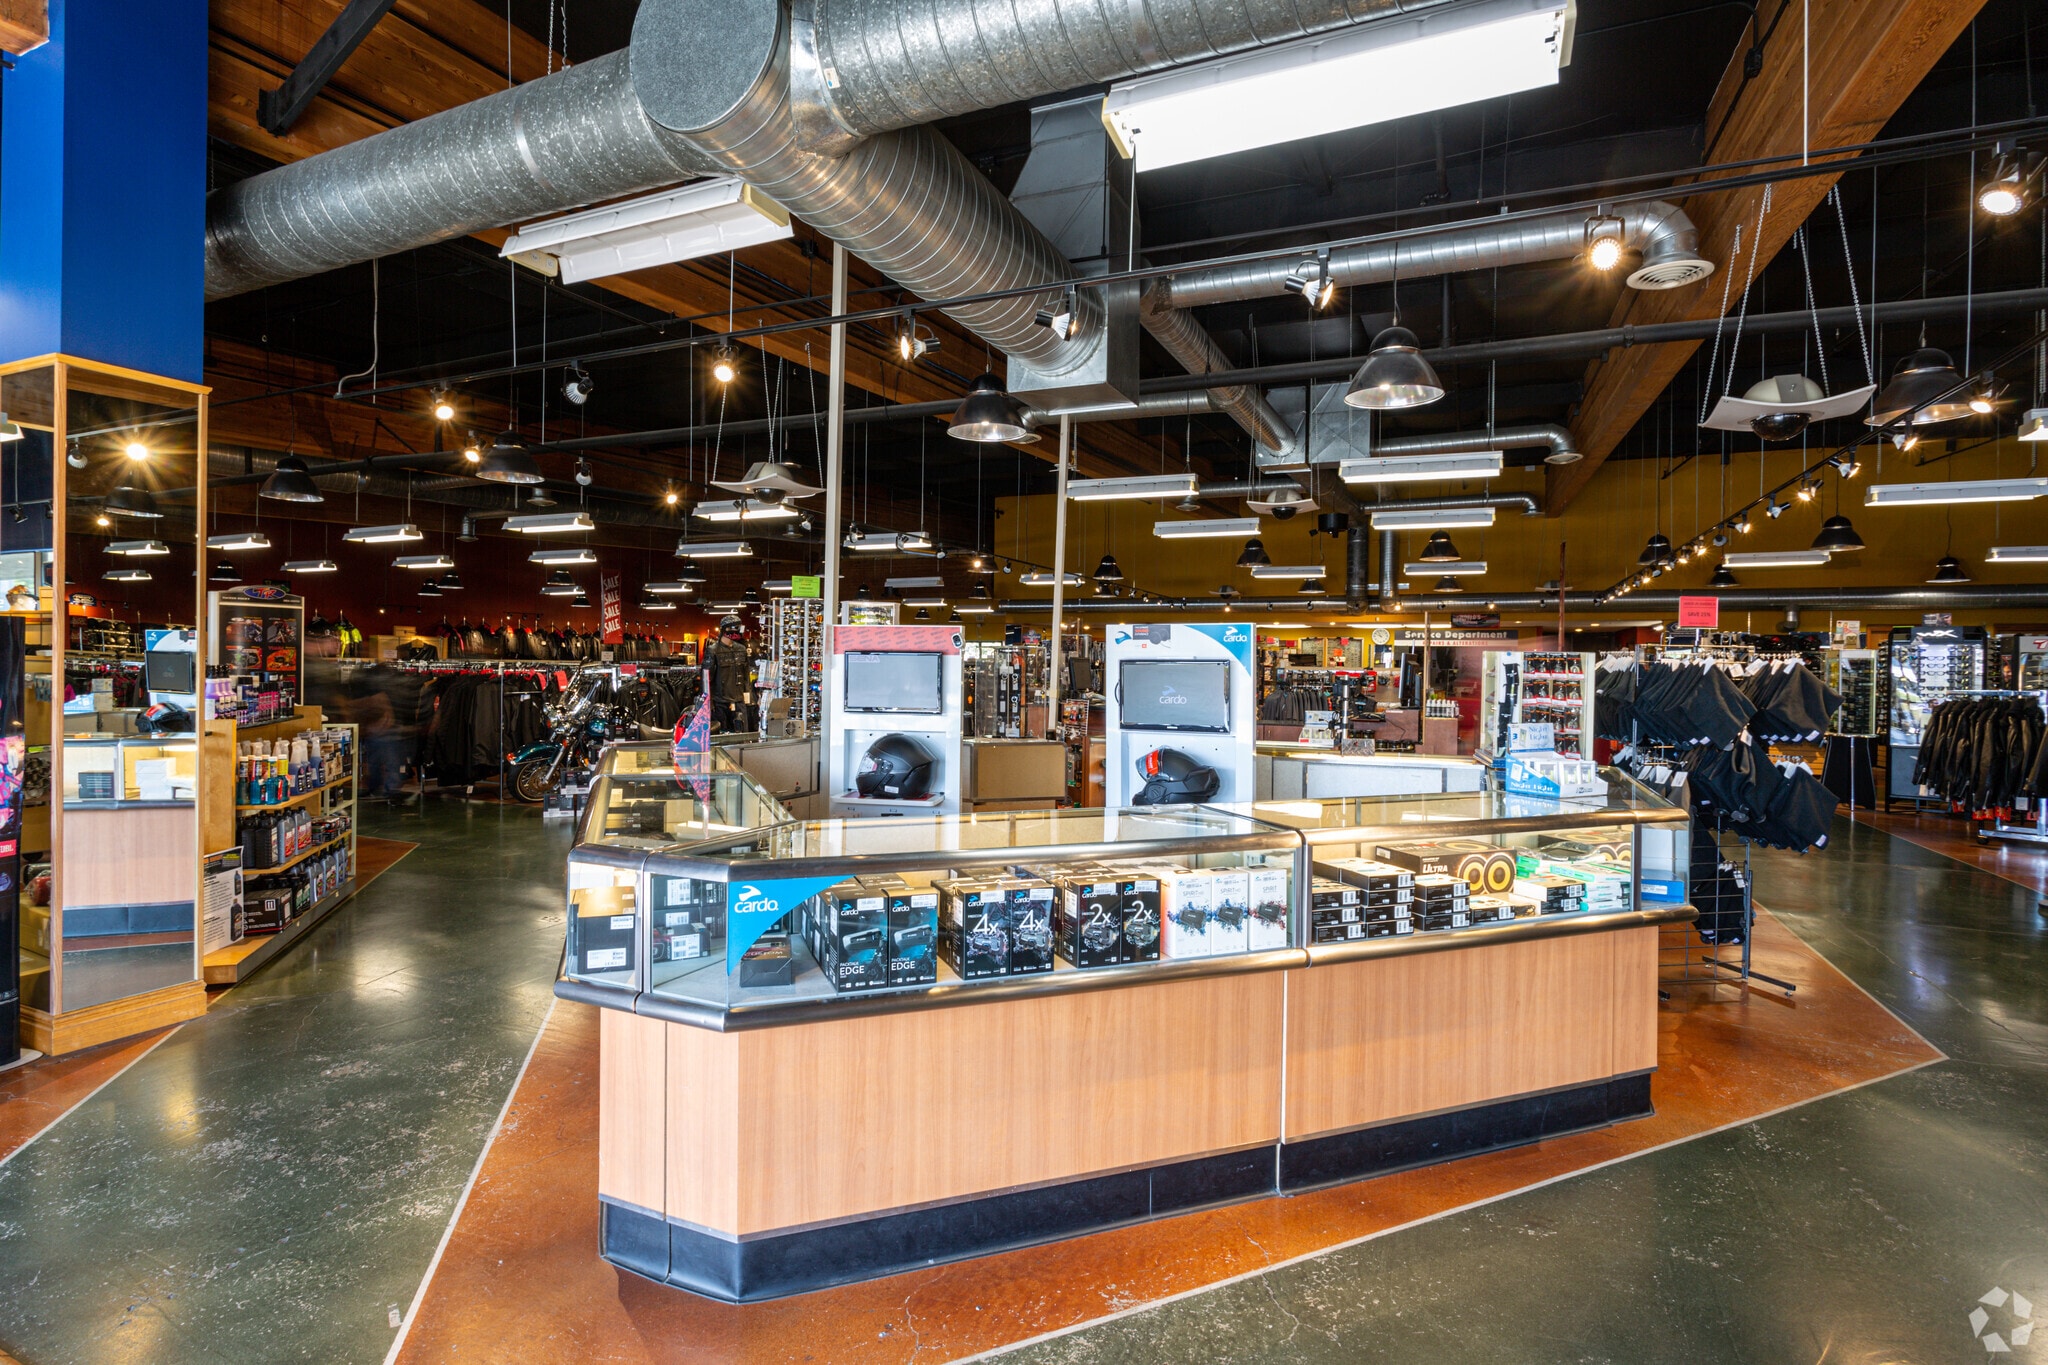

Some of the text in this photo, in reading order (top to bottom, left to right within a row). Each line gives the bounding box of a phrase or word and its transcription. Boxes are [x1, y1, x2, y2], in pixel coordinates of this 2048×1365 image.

[604, 576, 619, 590] SALE
[604, 590, 620, 605] SALE
[604, 604, 620, 620] SALE
[604, 618, 621, 634] SALE
[1223, 634, 1247, 642] cardo
[1444, 631, 1508, 640] Department
[1160, 694, 1187, 704] cardo
[734, 898, 779, 913] cardo
[1132, 900, 1152, 921] 2x
[1019, 909, 1044, 931] 4x
[1090, 903, 1111, 925] 2x
[973, 913, 999, 935] 4x
[840, 966, 865, 975] EDGE
[891, 961, 915, 971] EDGE
